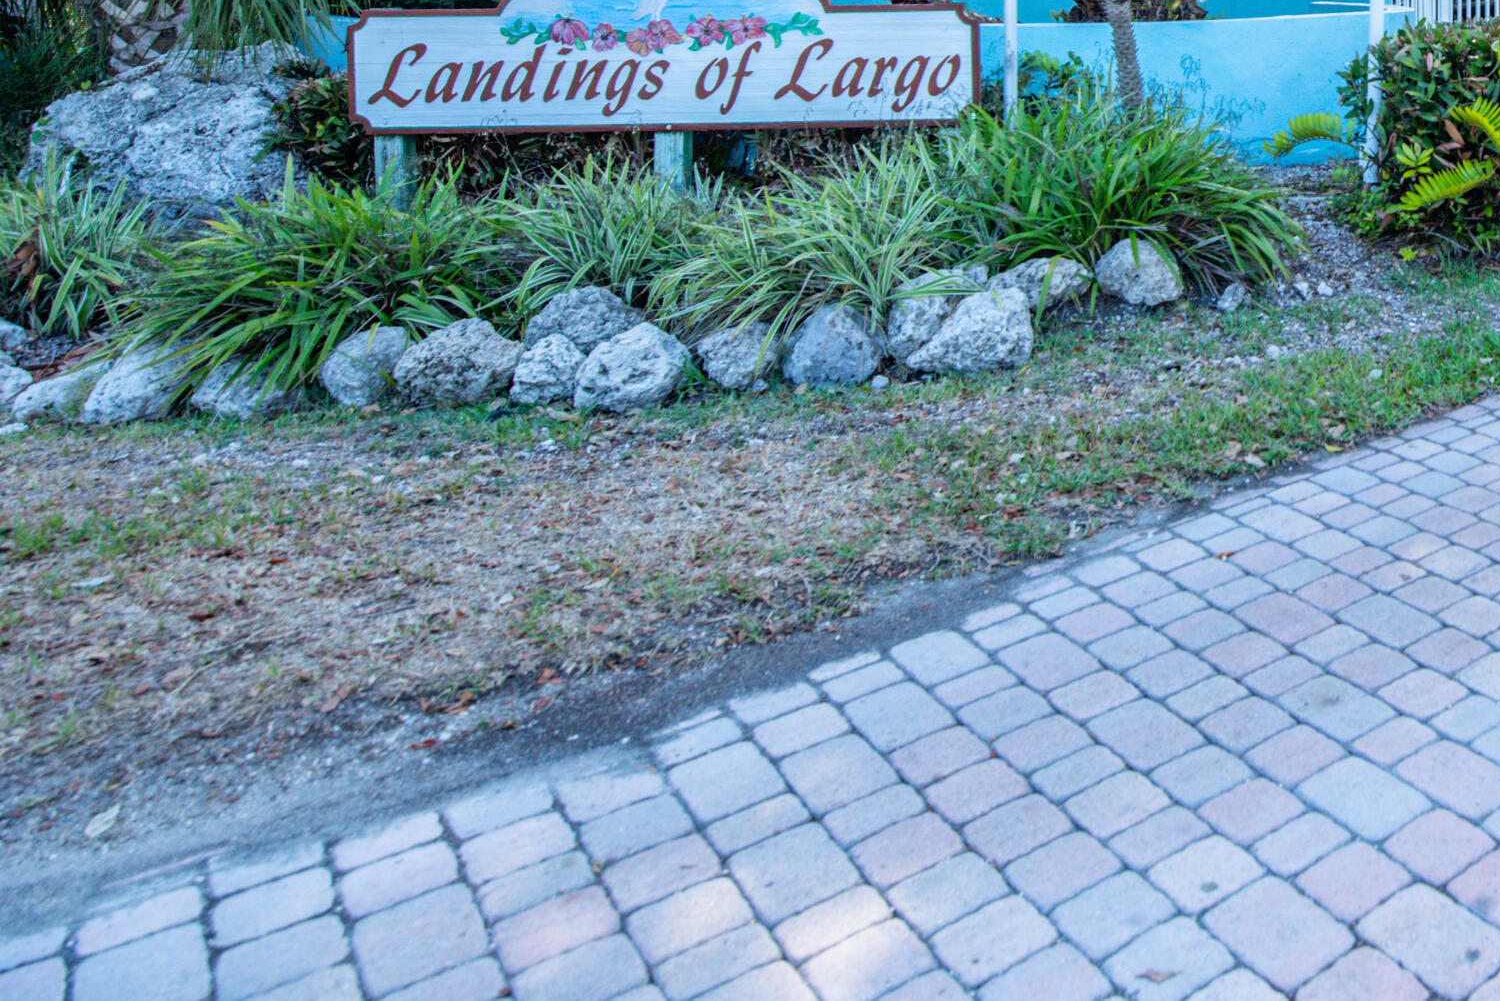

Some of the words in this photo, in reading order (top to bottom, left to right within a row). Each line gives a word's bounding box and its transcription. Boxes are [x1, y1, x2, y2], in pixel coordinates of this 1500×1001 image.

[368, 42, 669, 117] Landings
[694, 41, 762, 114] of
[774, 38, 961, 112] Largo
